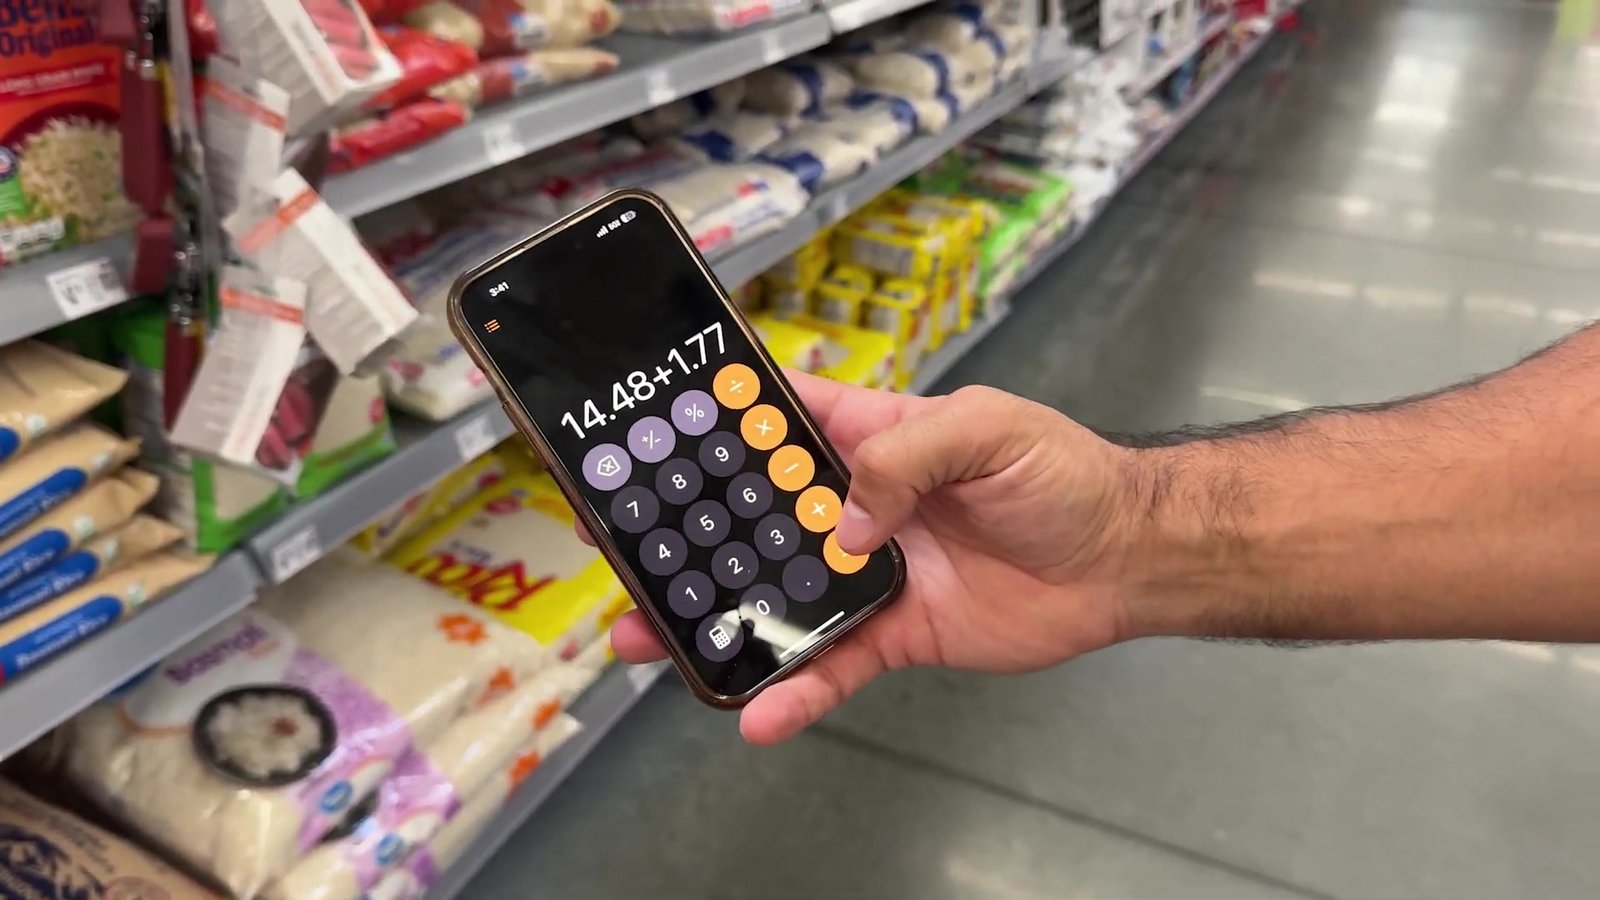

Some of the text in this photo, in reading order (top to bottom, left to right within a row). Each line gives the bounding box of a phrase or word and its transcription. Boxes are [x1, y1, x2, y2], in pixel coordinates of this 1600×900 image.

[488, 281, 510, 297] 3:41
[560, 322, 726, 440] 14.48+1.77
[626, 500, 640, 518] 7
[671, 473, 687, 490] 8
[714, 446, 729, 462] 9
[658, 542, 672, 560] 4
[699, 514, 715, 531] 5
[742, 487, 757, 503] 6
[685, 586, 698, 602] 1
[728, 557, 743, 574] 2
[770, 529, 785, 545] 3
[756, 600, 771, 616] 0
